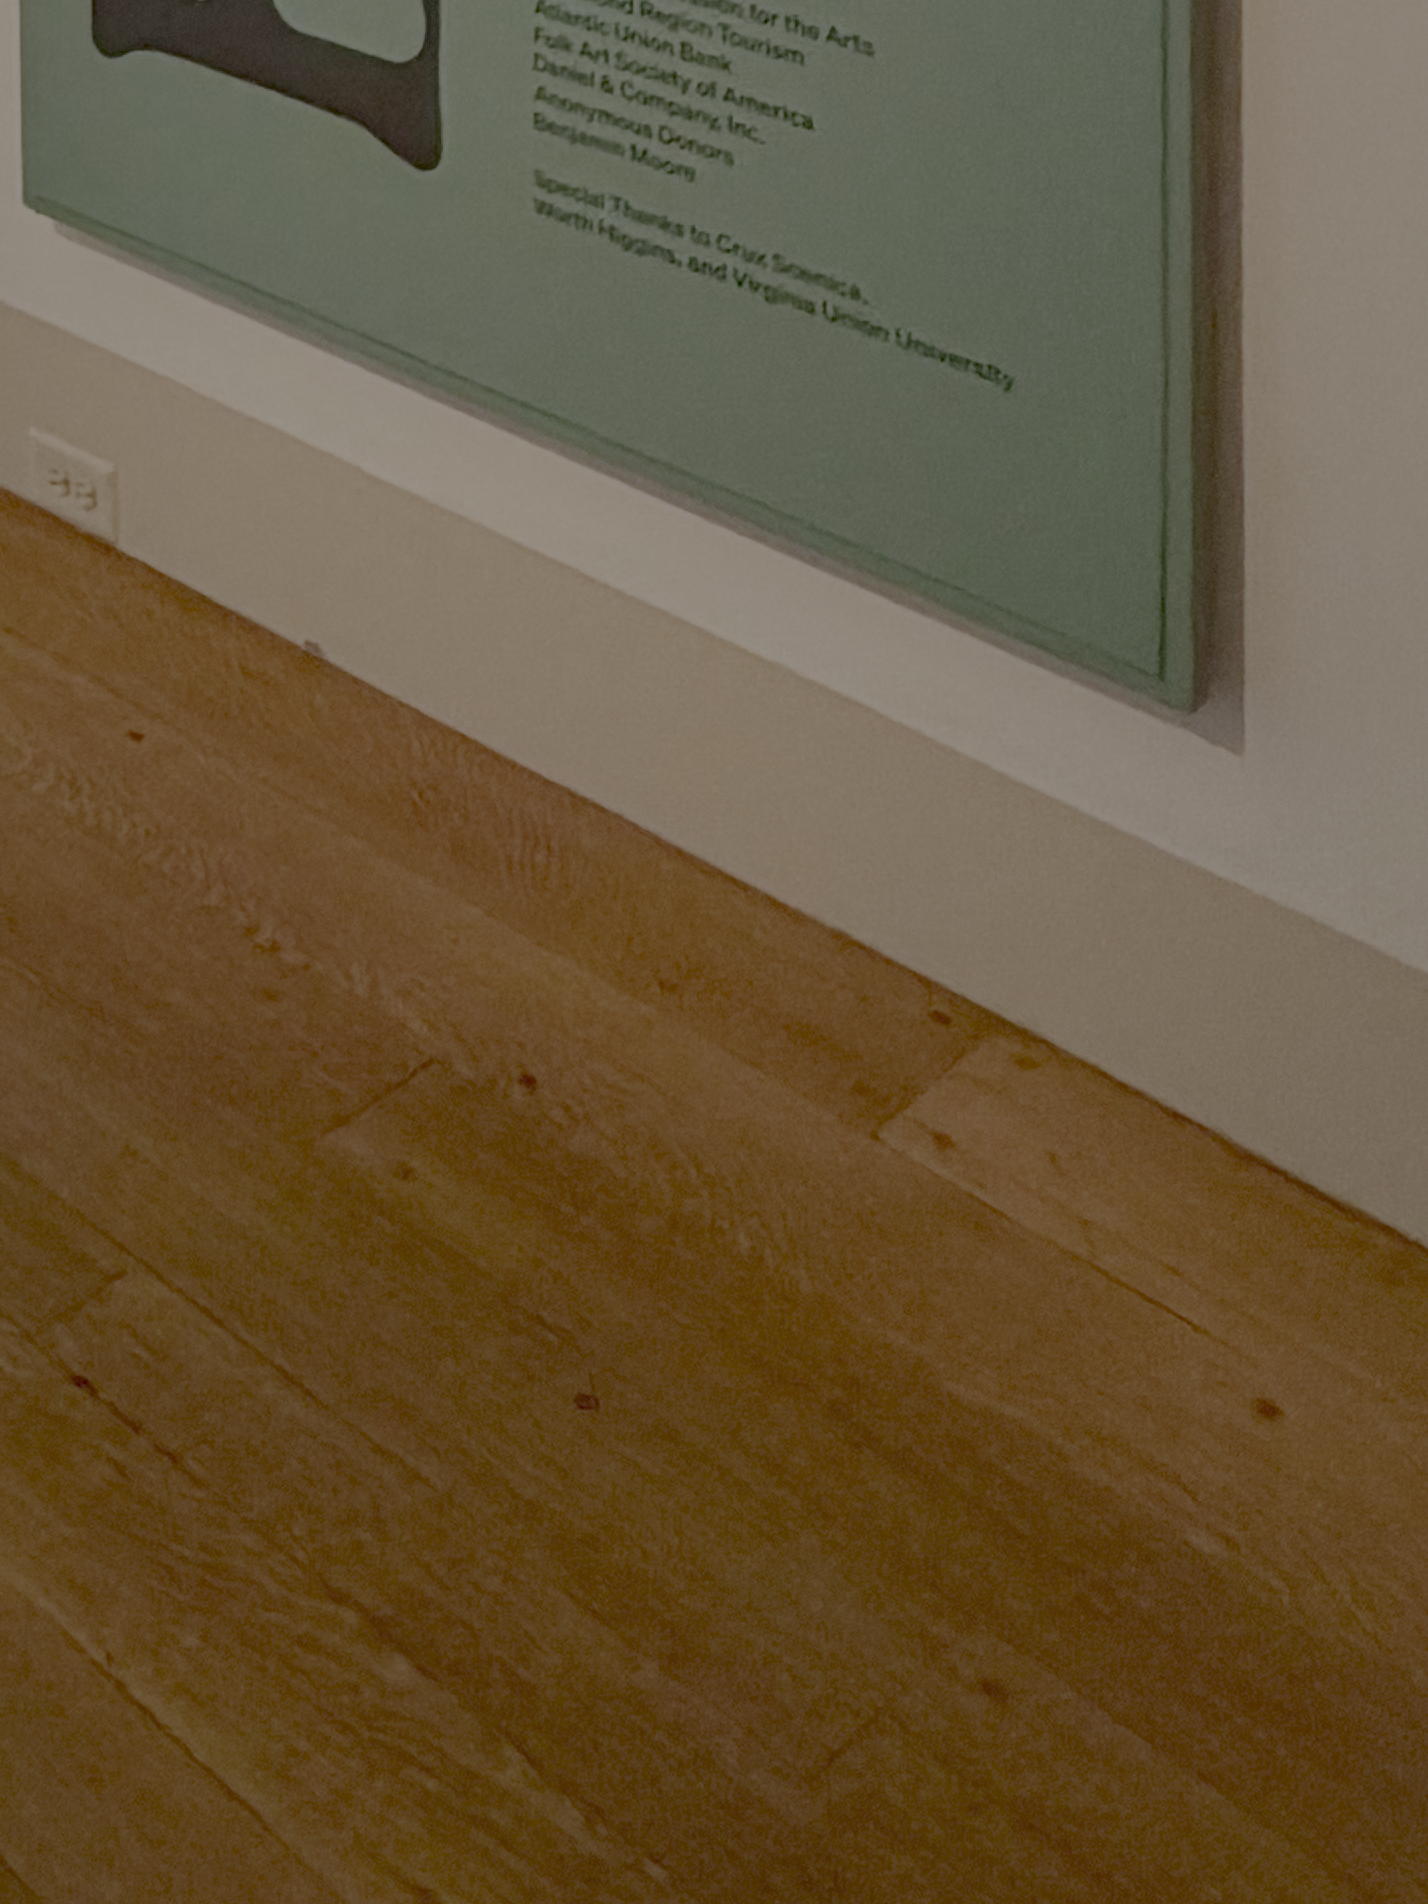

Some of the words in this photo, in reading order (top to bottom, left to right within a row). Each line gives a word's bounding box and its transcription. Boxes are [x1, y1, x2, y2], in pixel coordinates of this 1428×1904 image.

[534, 0, 609, 36] Atlantic
[614, 23, 674, 56] Union
[680, 41, 731, 74] Bank
[640, 0, 713, 37] Region
[718, 23, 805, 66] Tourism
[749, 4, 779, 27] for
[785, 15, 820, 41] the
[826, 26, 875, 57] Arts
[532, 52, 595, 87] Daniel
[600, 75, 614, 95] &
[579, 42, 609, 64] Art
[615, 52, 691, 94] Society
[696, 82, 717, 99] of
[722, 87, 815, 131] America
[534, 86, 652, 139] Anonymous
[658, 125, 734, 167] Donors
[690, 225, 711, 248] to
[687, 257, 727, 282] and
[733, 268, 816, 316] Virginia
[822, 300, 889, 341] Union
